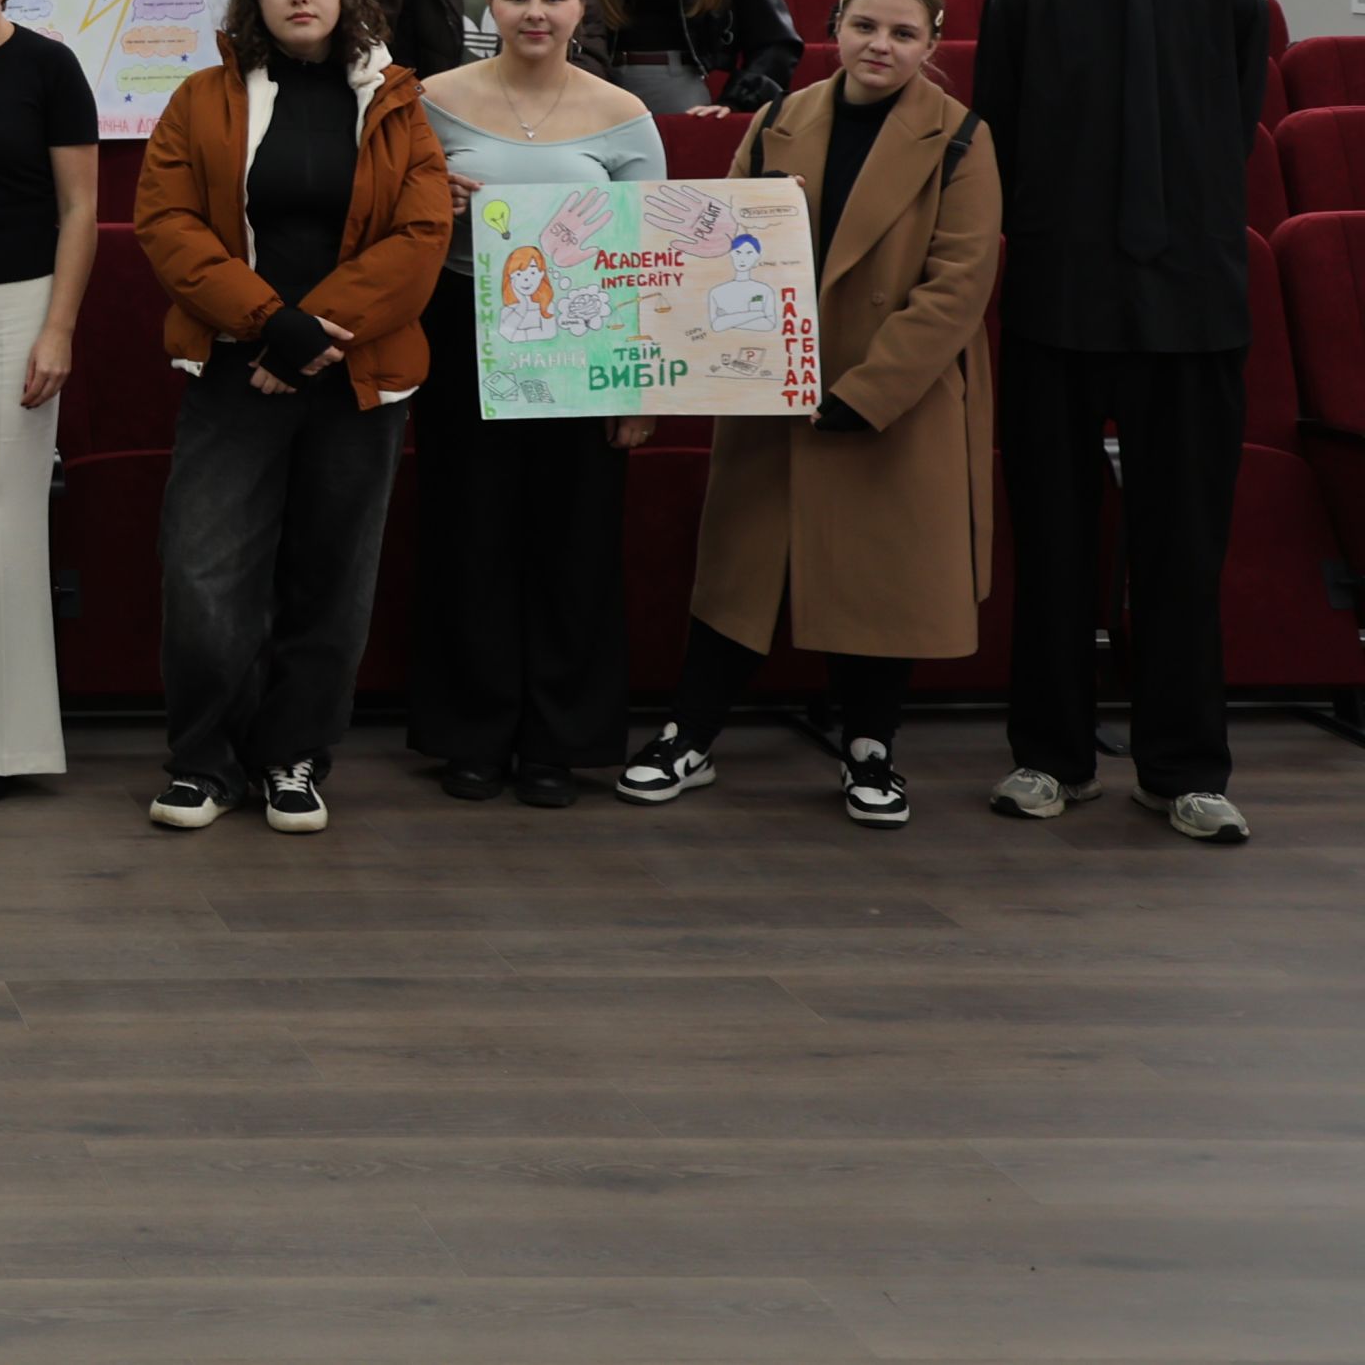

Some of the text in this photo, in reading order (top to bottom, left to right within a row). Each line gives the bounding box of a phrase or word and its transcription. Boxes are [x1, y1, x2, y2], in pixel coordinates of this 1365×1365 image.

[613, 342, 662, 362] ТВІЙ
[800, 318, 817, 407] ОБМАН
[588, 358, 689, 391] ВИБІР
